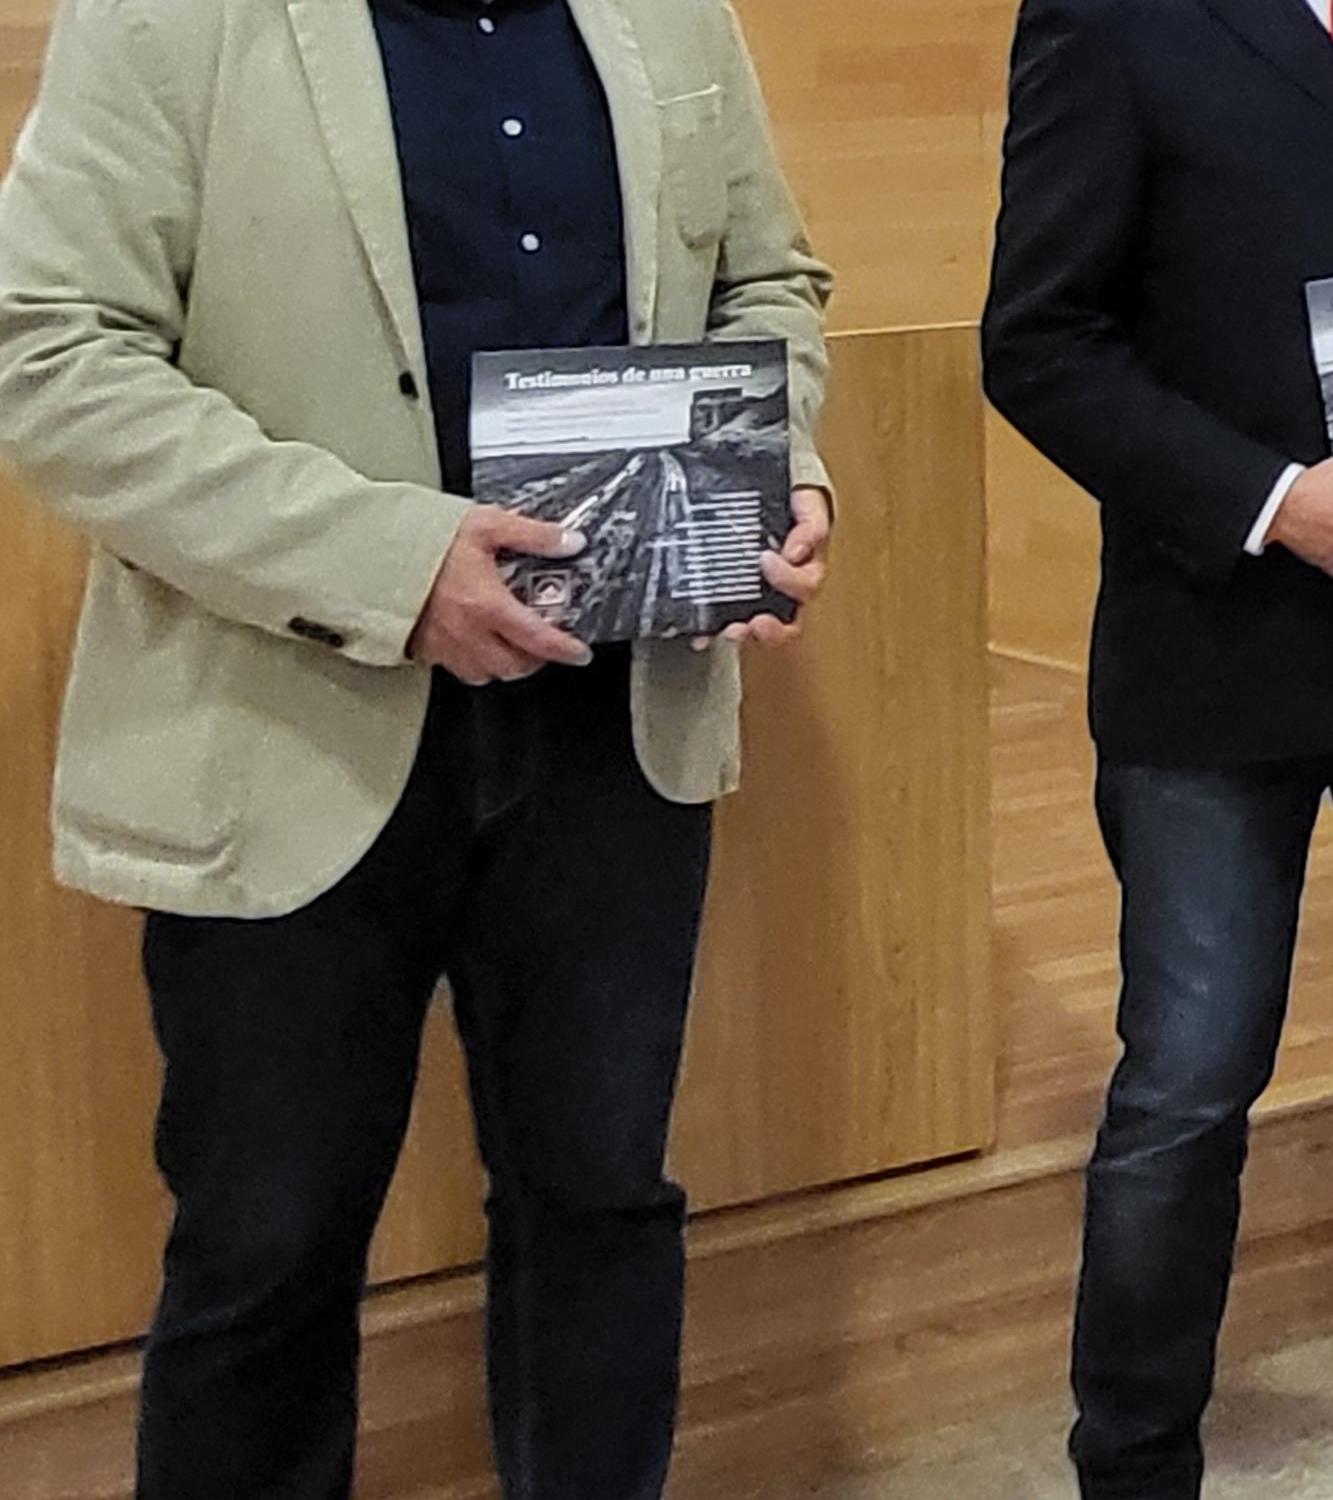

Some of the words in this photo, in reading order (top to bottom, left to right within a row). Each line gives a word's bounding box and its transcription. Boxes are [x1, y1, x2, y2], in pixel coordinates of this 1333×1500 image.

[504, 368, 618, 390] Testimonios
[622, 366, 646, 384] de
[651, 367, 685, 381] una
[690, 364, 752, 382] guerra
